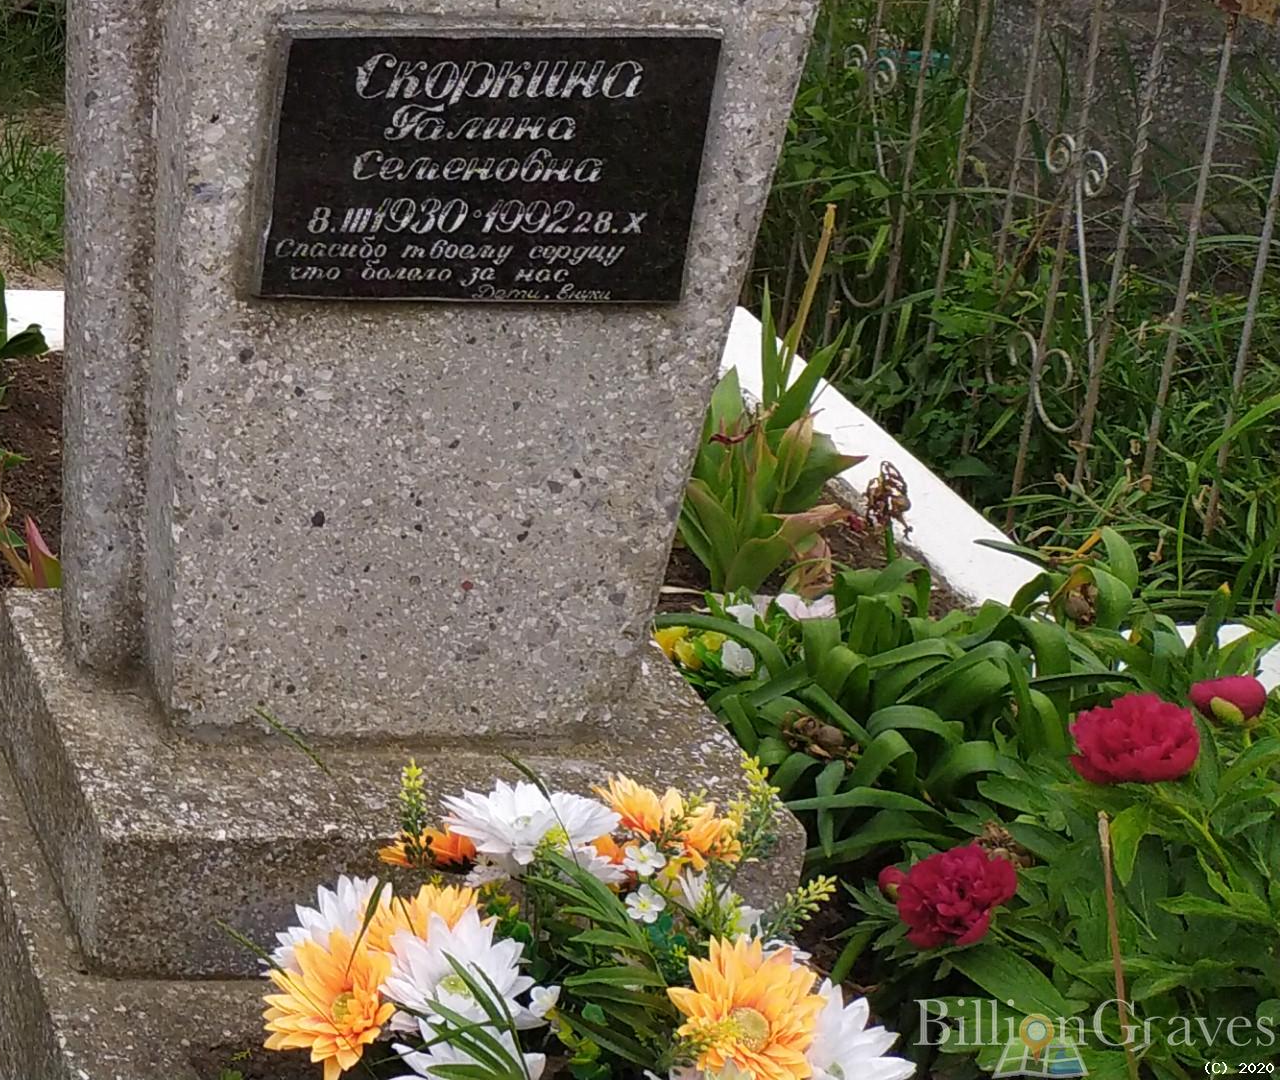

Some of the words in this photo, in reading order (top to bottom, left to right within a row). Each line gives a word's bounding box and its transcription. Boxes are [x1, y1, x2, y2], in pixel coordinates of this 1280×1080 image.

[355, 53, 644, 105] Скоркина
[383, 103, 577, 141] Галина
[352, 148, 607, 183] Семеновна
[275, 235, 388, 259] Спасибо
[400, 239, 514, 265] твоему
[528, 245, 626, 267] сердцу
[290, 266, 341, 281] что
[460, 267, 496, 287] за
[514, 269, 569, 283] нас
